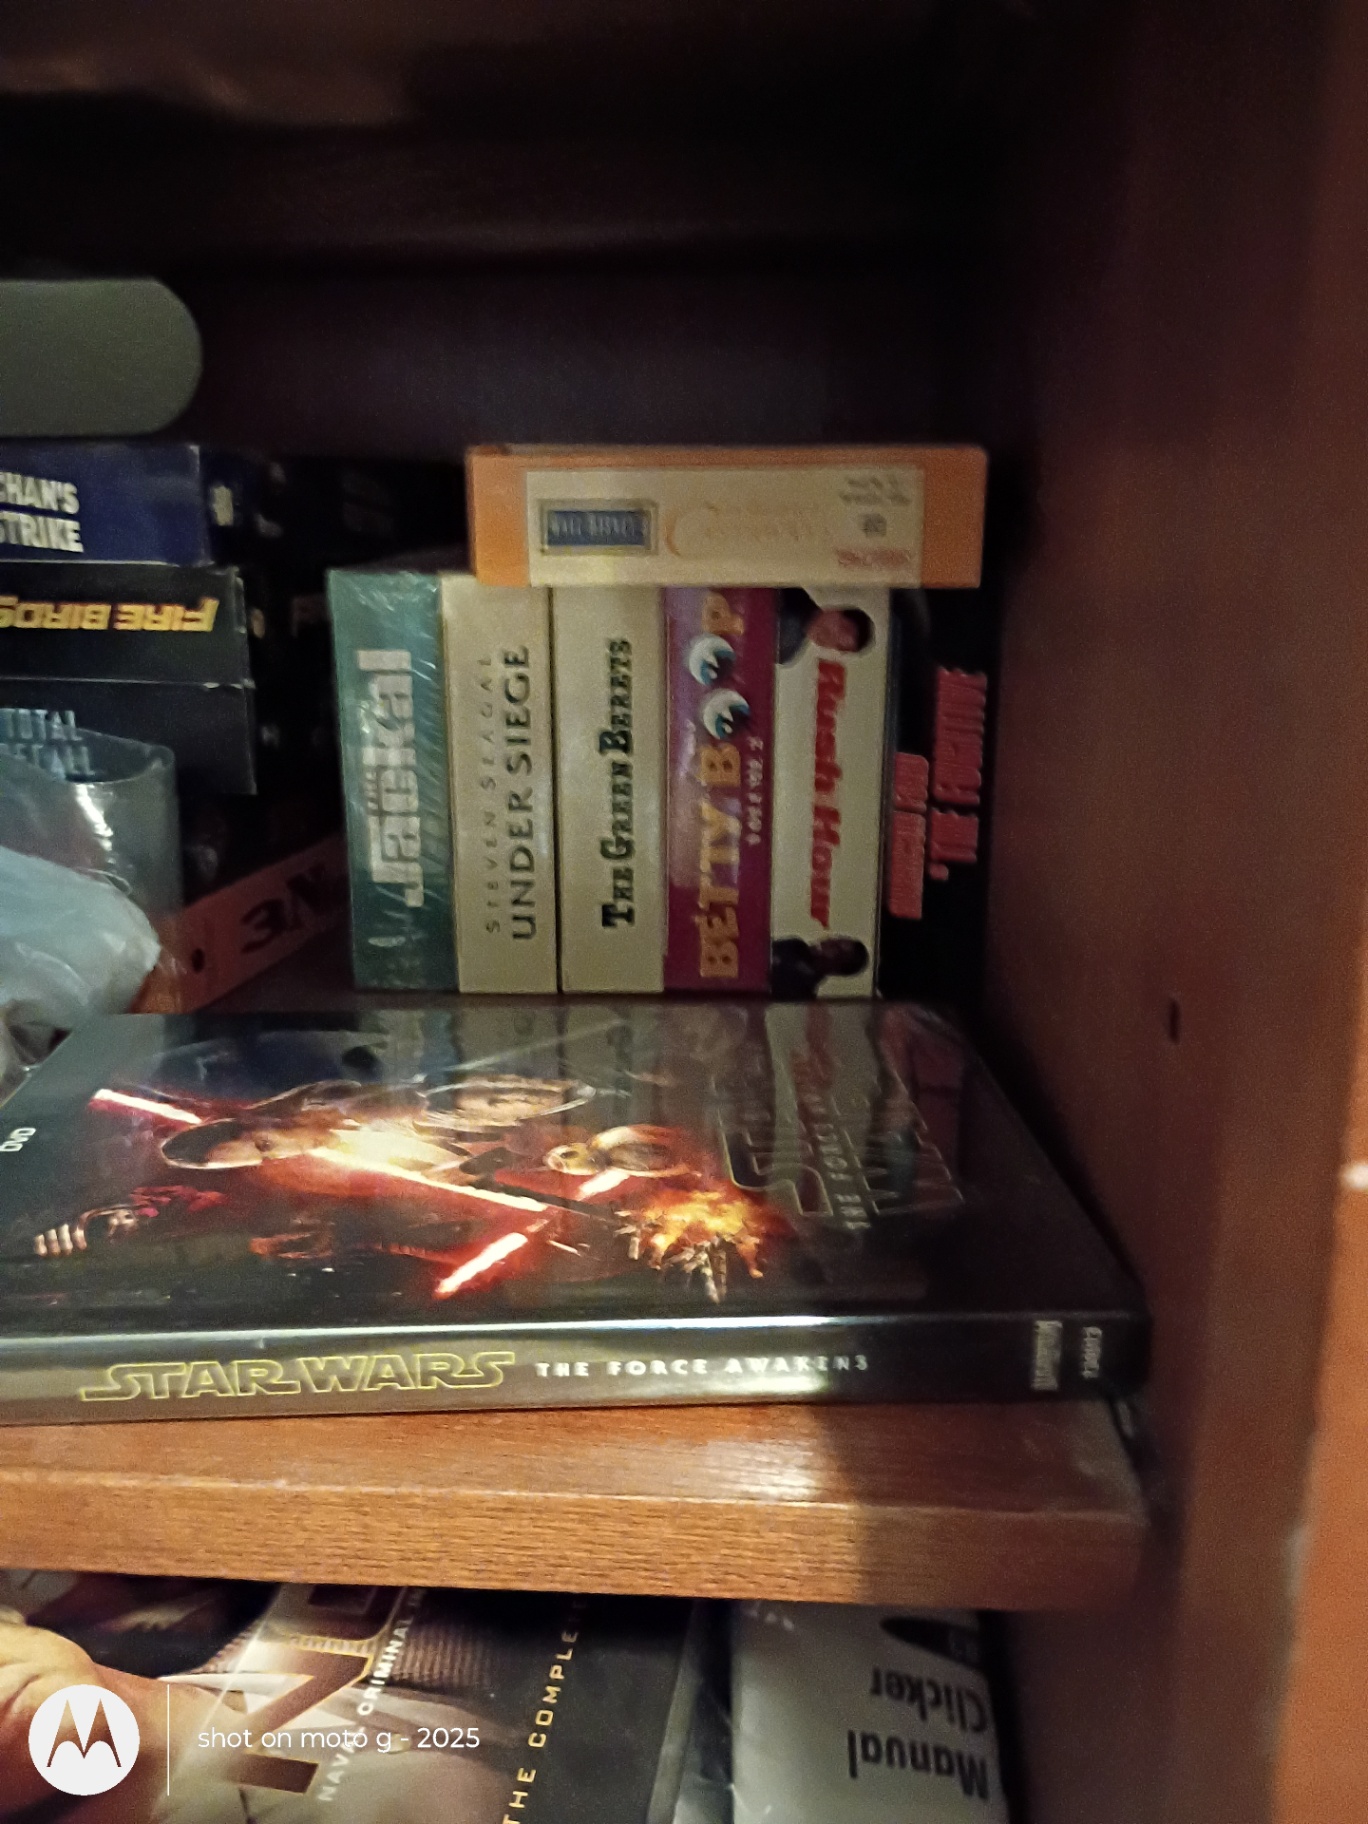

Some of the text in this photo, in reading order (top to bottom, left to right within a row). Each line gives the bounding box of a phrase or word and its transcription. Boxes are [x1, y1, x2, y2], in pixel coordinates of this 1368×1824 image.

[113, 598, 220, 632] FIRE
[503, 645, 538, 942] UNDER SIEGE
[695, 795, 742, 978] BETTY
[79, 1350, 868, 1402] STAR WARS THE FORCE AWAKENS
[871, 1667, 988, 1733] Clicker
[847, 1729, 990, 1799] Manual
